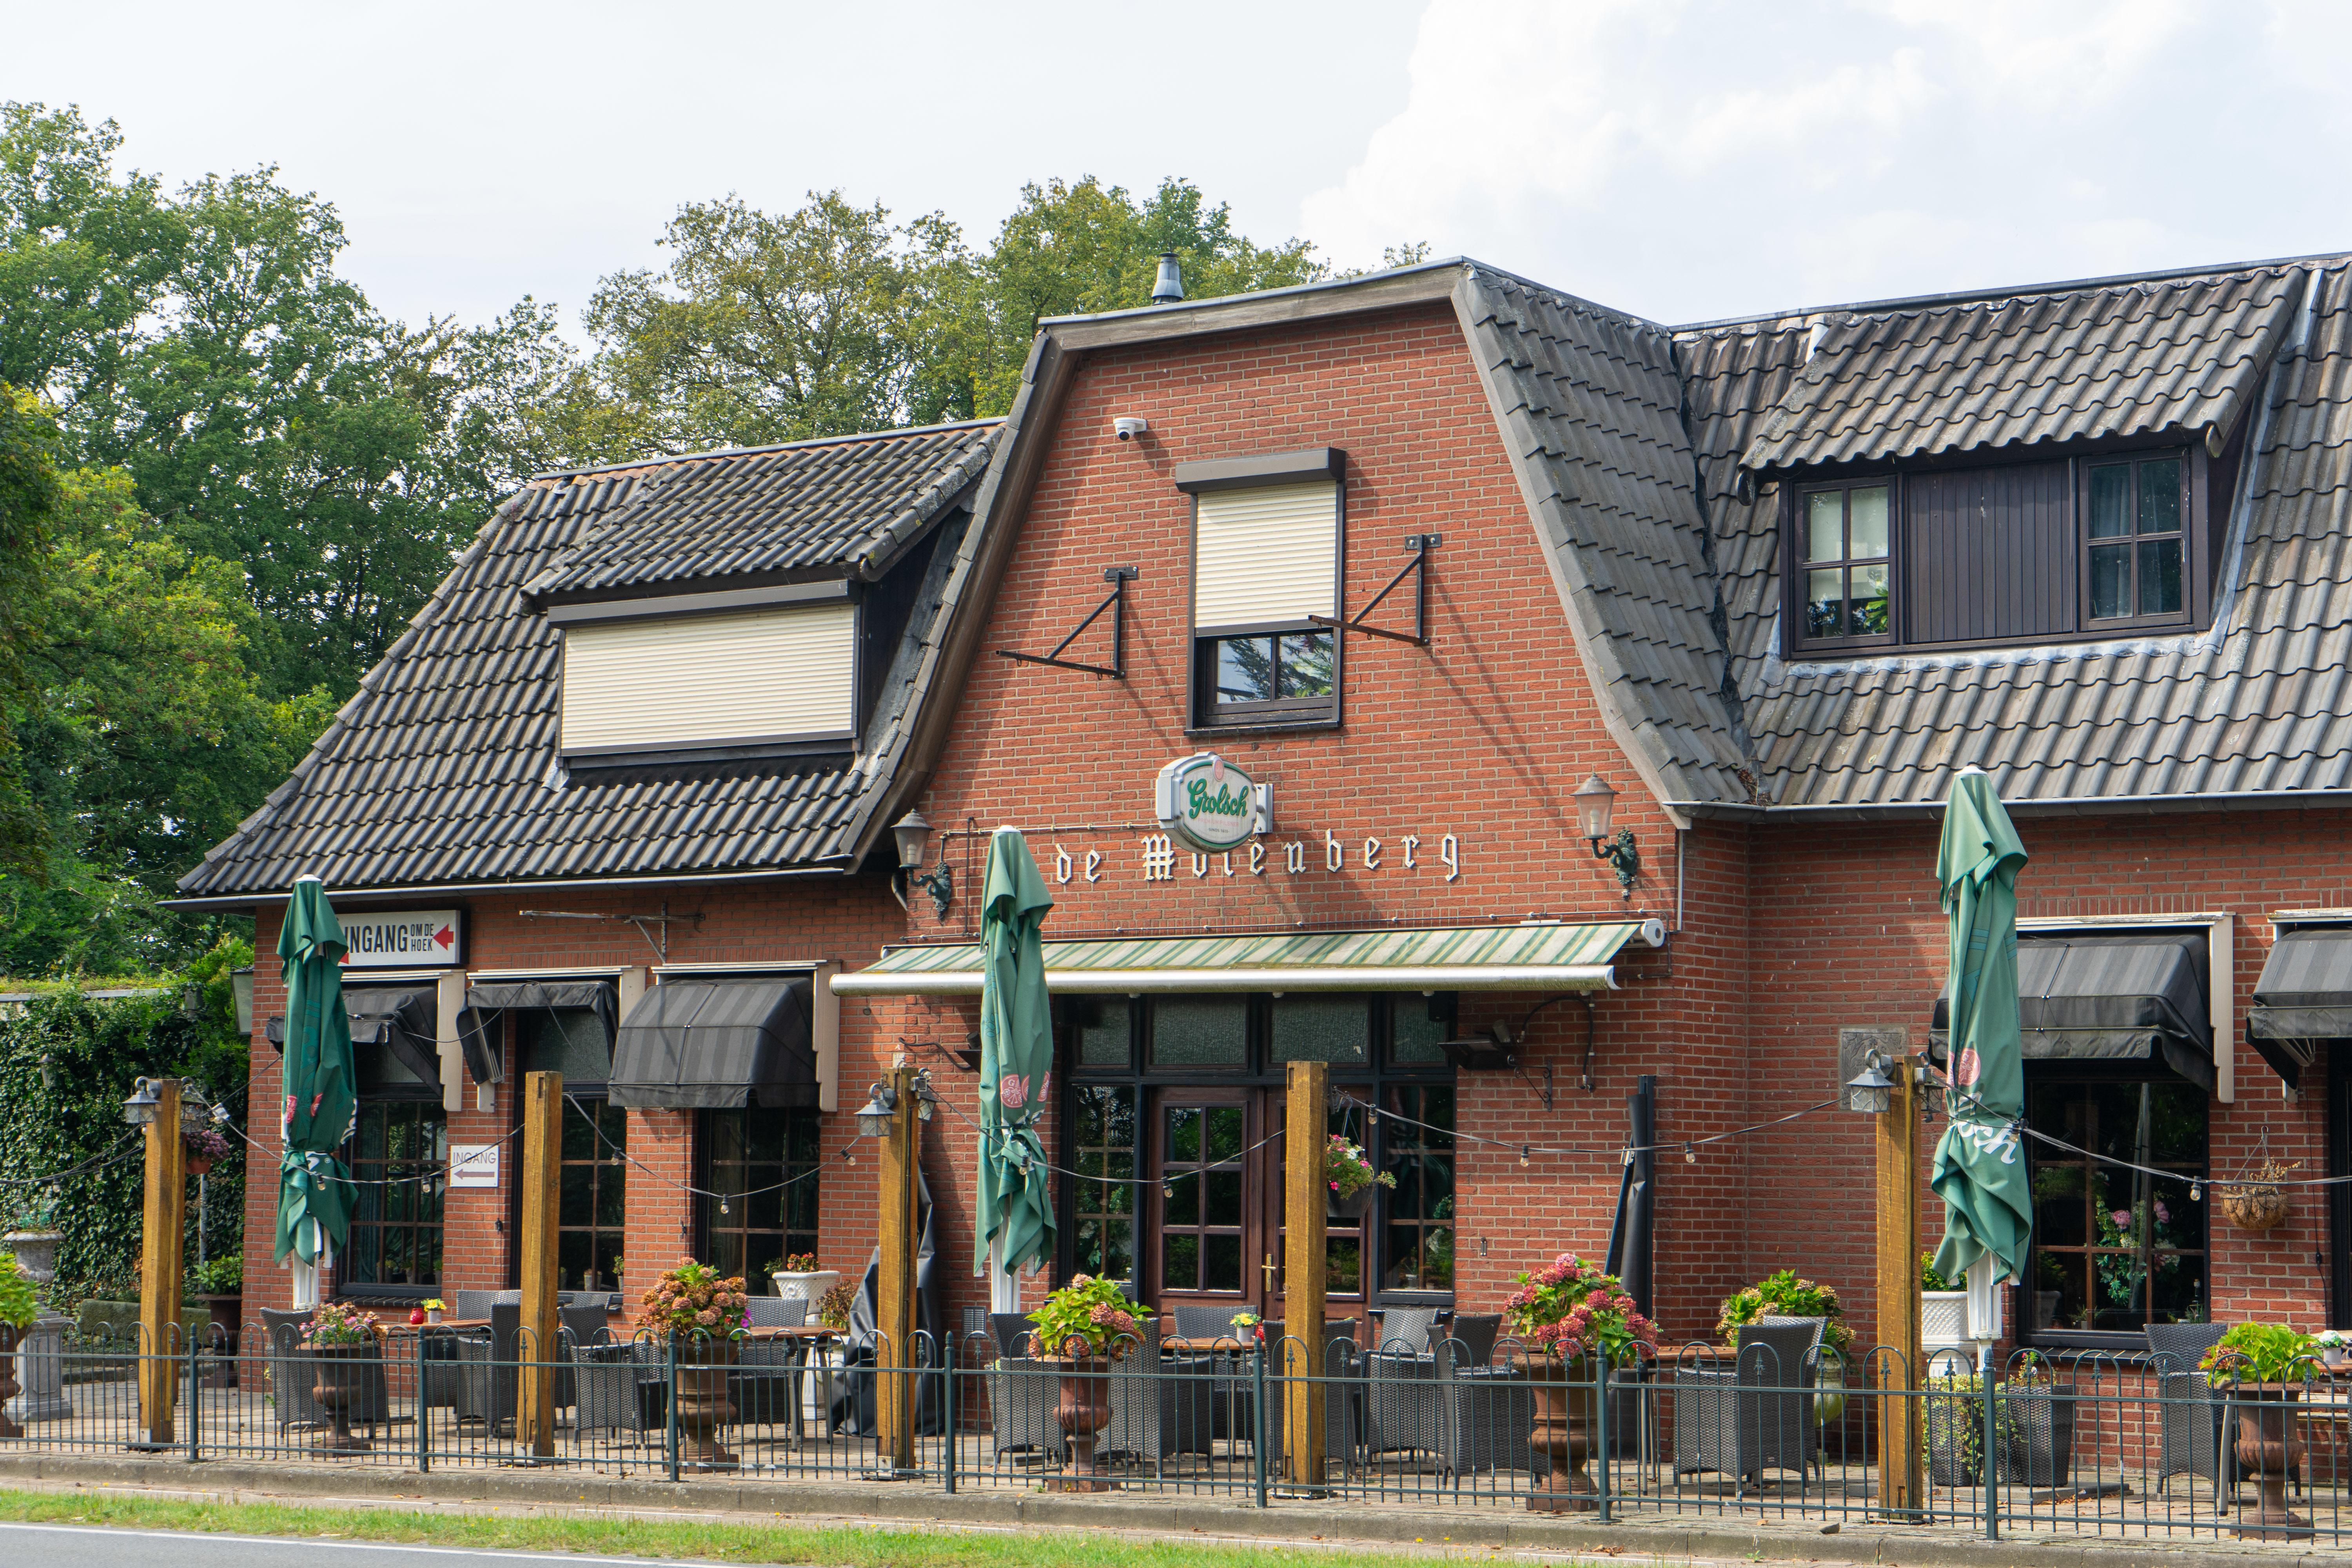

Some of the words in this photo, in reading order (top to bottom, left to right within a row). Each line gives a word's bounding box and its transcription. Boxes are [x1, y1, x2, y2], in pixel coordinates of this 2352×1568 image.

[1187, 778, 1248, 819] Grolsch
[1056, 843, 1101, 884] de
[411, 924, 422, 936] OM
[424, 924, 434, 936] DE
[411, 938, 433, 951] HOEK
[453, 1152, 496, 1163] INGANG
